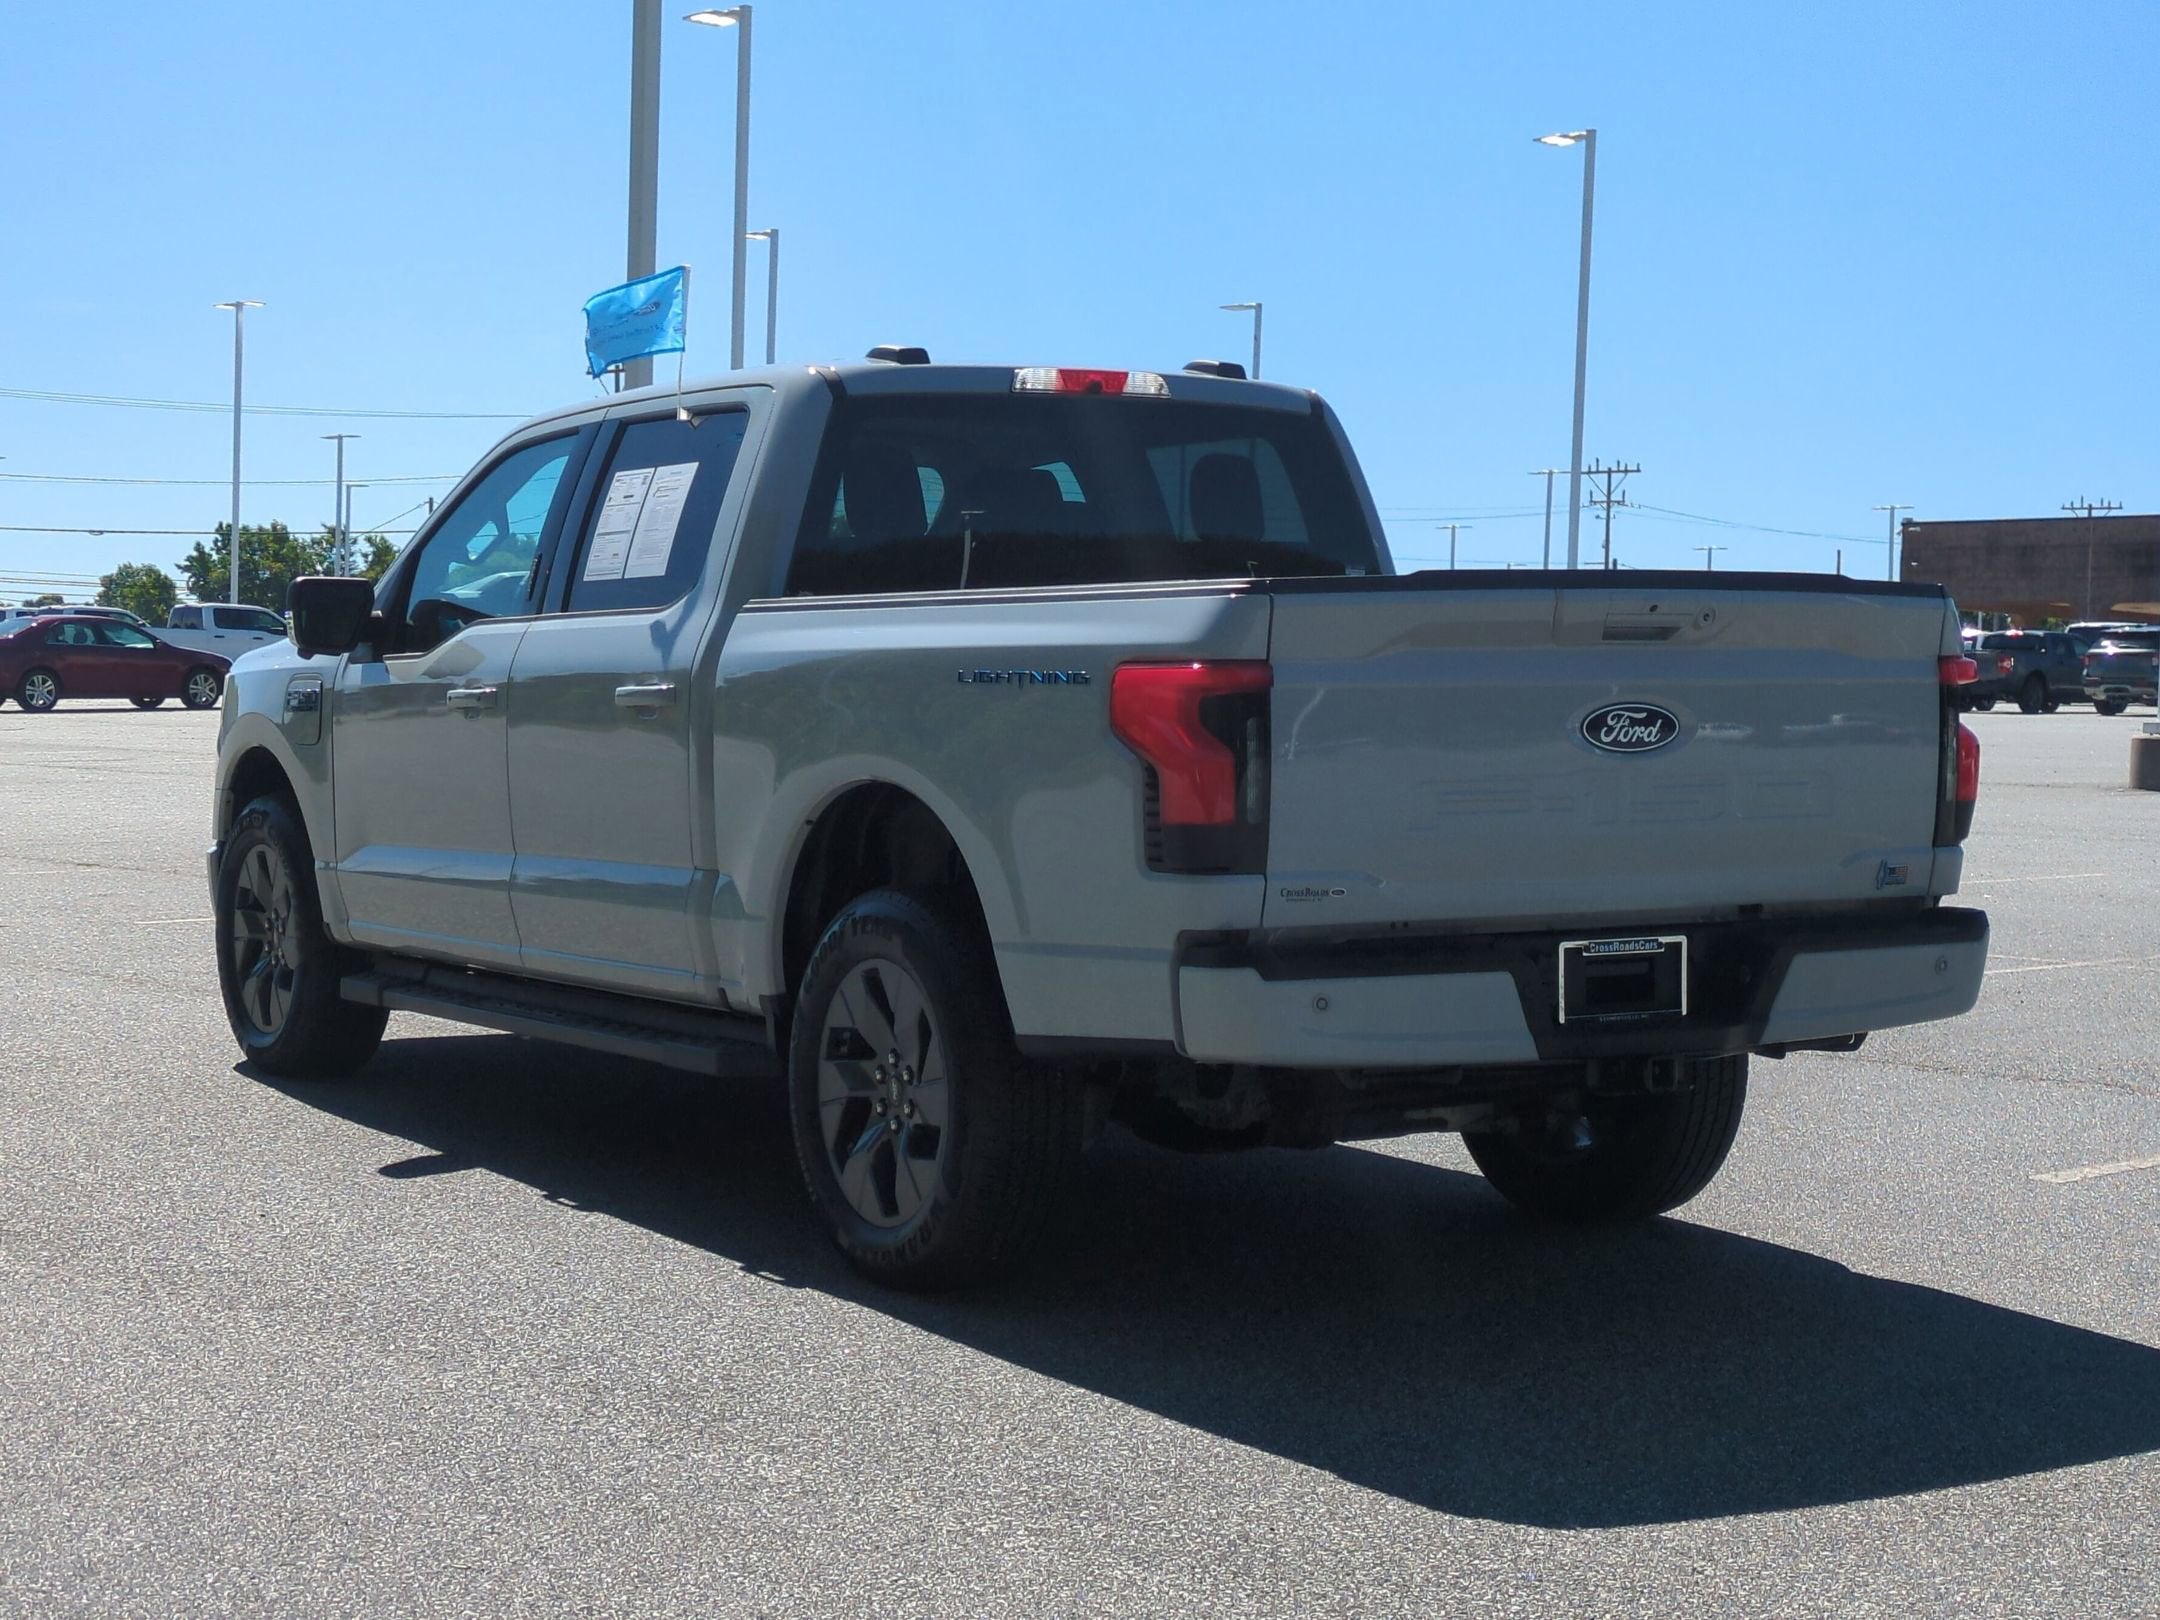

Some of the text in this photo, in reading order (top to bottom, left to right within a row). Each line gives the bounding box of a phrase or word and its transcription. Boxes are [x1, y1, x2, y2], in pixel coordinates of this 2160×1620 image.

[957, 669, 1091, 687] LIGHTNING
[1600, 710, 1662, 743] Ford
[1589, 940, 1659, 953] CrossRoadsCars
